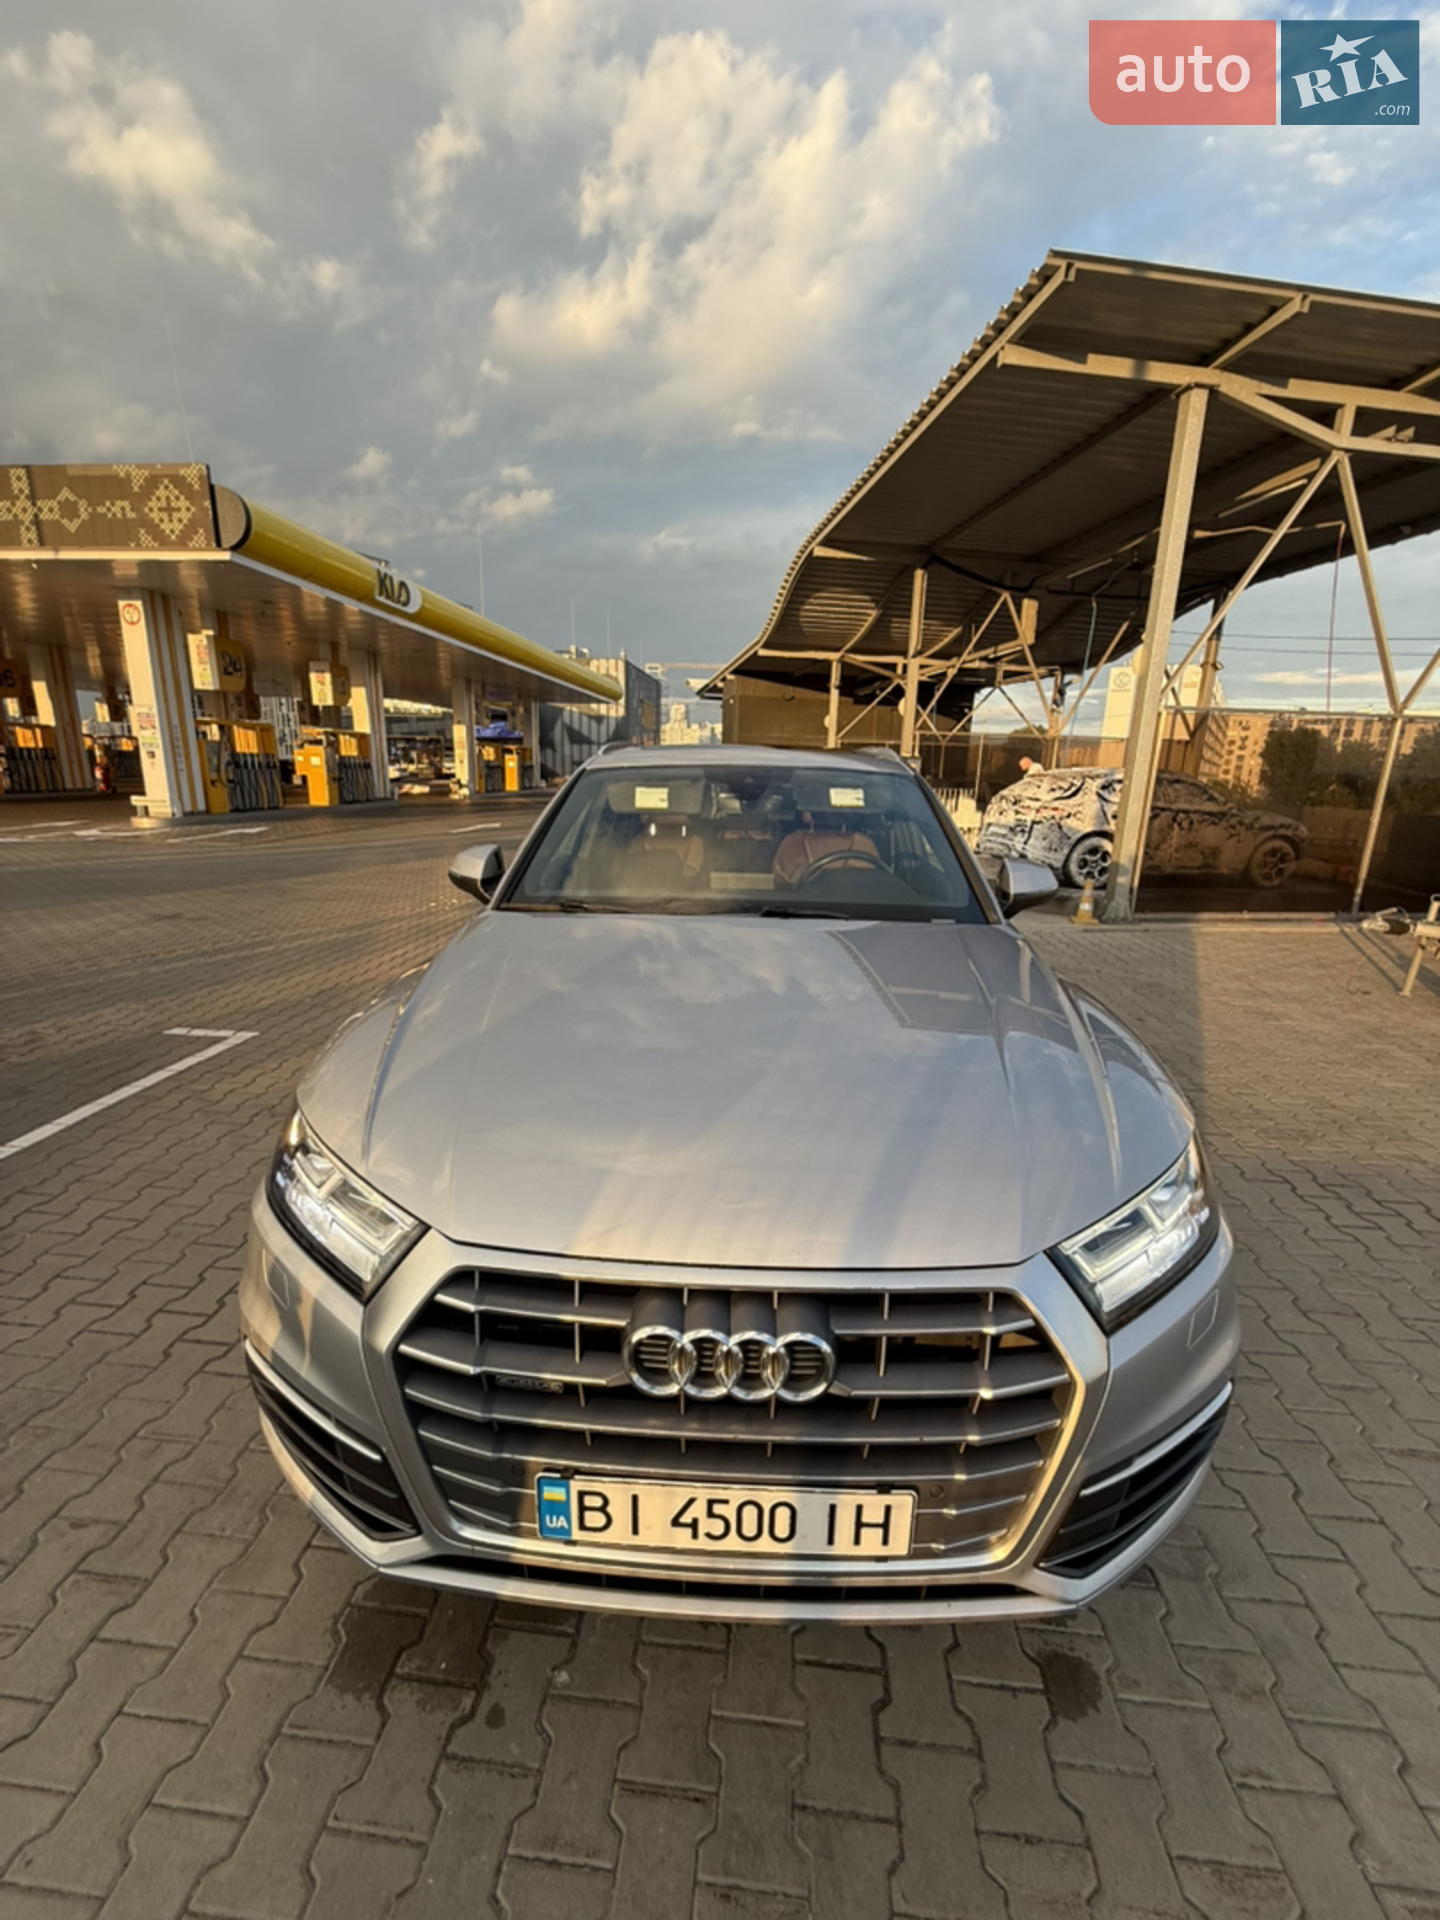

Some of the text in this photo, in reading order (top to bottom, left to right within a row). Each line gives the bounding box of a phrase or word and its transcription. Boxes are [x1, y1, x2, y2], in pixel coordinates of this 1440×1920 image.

[377, 569, 411, 608] KLO
[0, 668, 16, 688] 6
[545, 1514, 569, 1529] UA
[577, 1489, 893, 1547] BI 4500 IH
